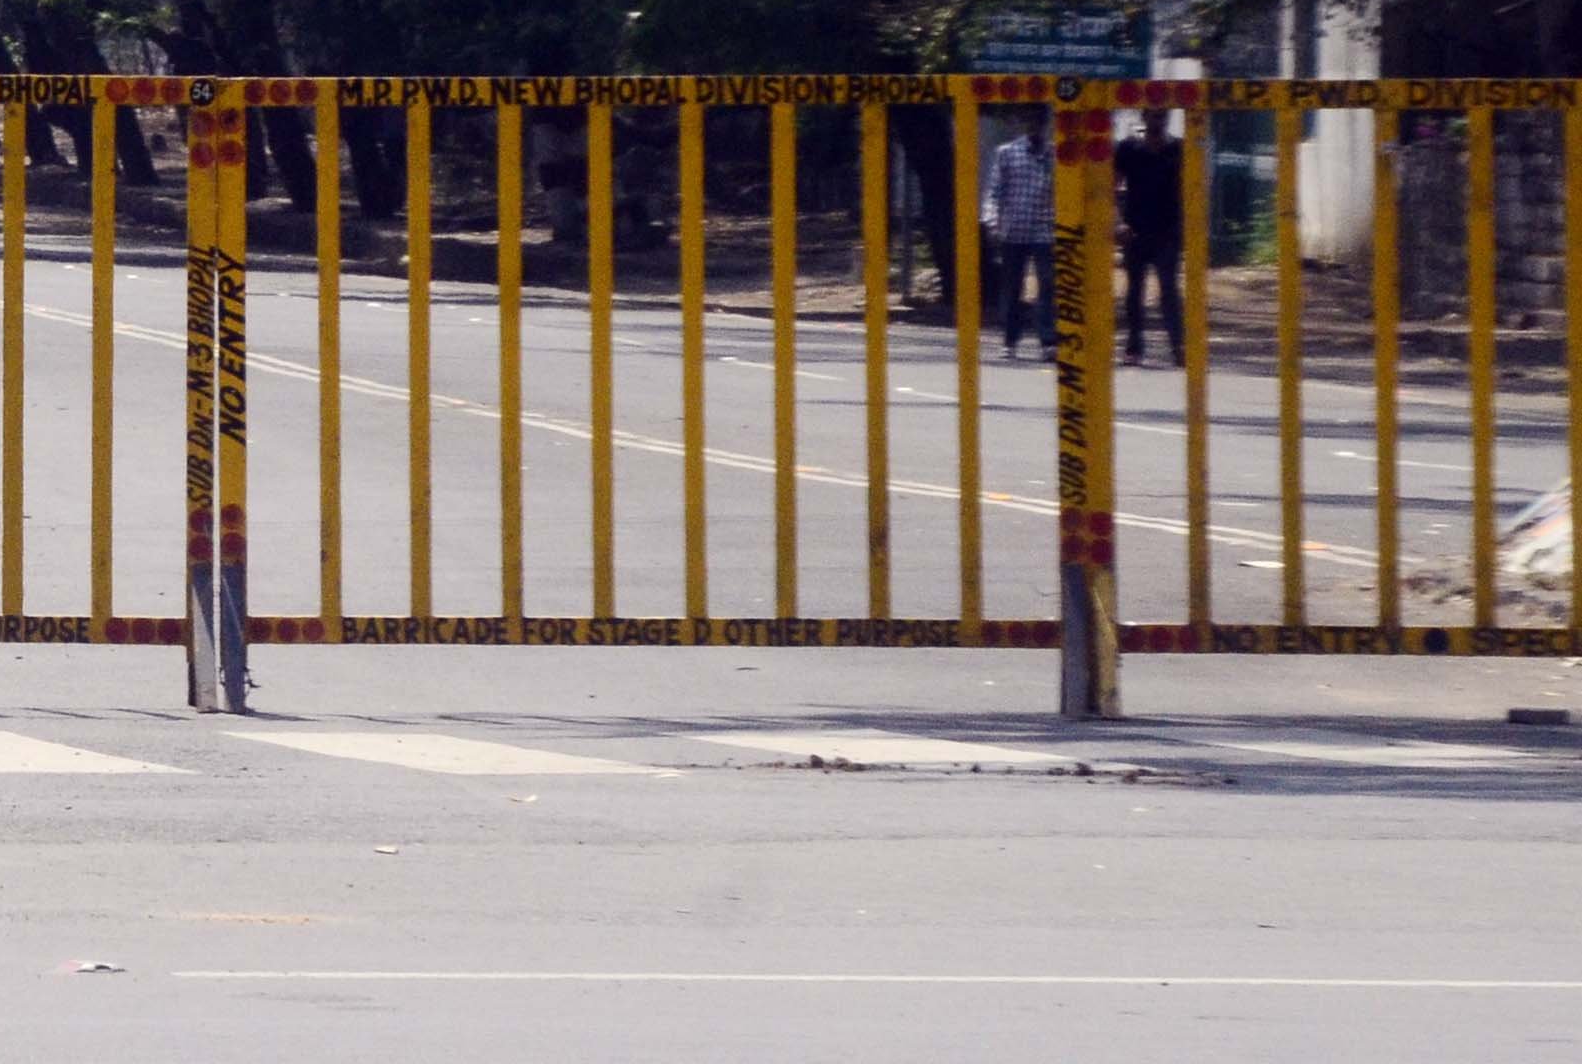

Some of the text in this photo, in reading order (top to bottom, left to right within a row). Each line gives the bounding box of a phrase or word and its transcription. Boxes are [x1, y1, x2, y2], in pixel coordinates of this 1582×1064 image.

[491, 78, 566, 105] NEW
[575, 77, 686, 104] BHOPAL
[1407, 81, 1577, 107] DIVISION
[188, 244, 216, 340] BHOPAL
[1054, 222, 1084, 325] BHOPAL
[219, 250, 246, 446] NO ENTRY
[187, 460, 214, 508] SUB
[1057, 457, 1086, 507] SUB
[343, 617, 508, 645] BARRICADE
[522, 618, 577, 645] FOR
[587, 619, 682, 646] STAGE
[724, 619, 822, 647] OTHER
[836, 620, 960, 648] PURPOSE
[1212, 628, 1259, 653] NO
[1278, 628, 1401, 654] ENTRY
